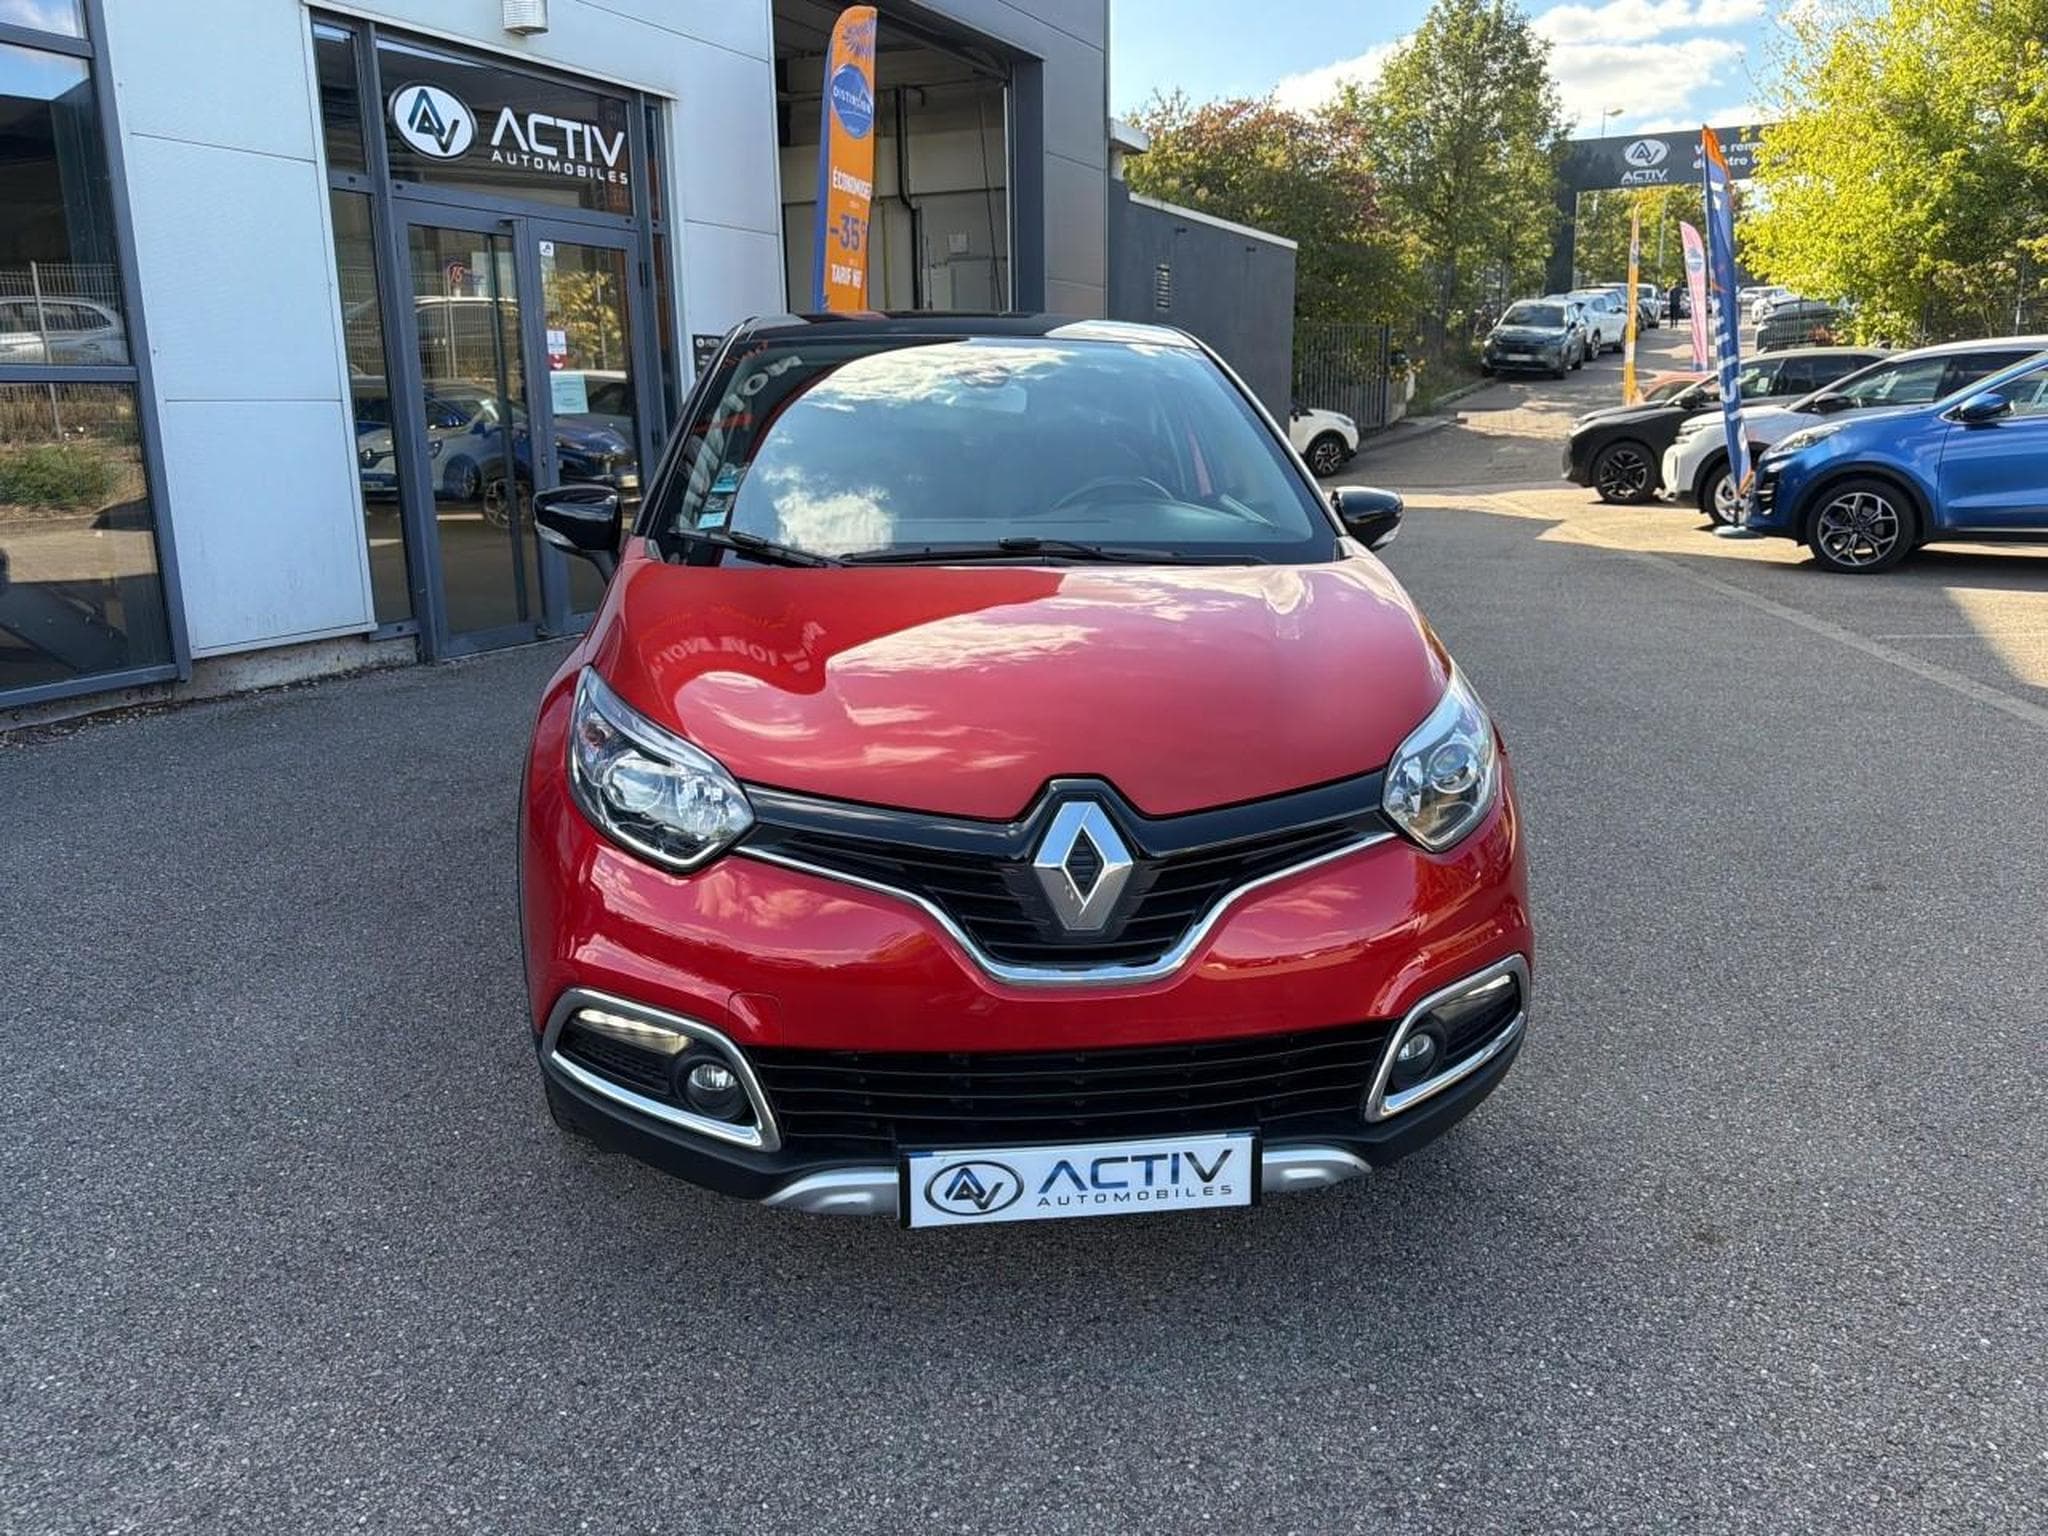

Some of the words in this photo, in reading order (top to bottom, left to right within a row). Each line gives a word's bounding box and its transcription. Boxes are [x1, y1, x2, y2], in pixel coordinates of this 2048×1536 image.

[491, 106, 625, 167] ACTIV
[491, 150, 629, 185] AUTOMOBILES
[1038, 1149, 1234, 1195] ACTIV
[1038, 1184, 1233, 1207] AUTOMOBILES
